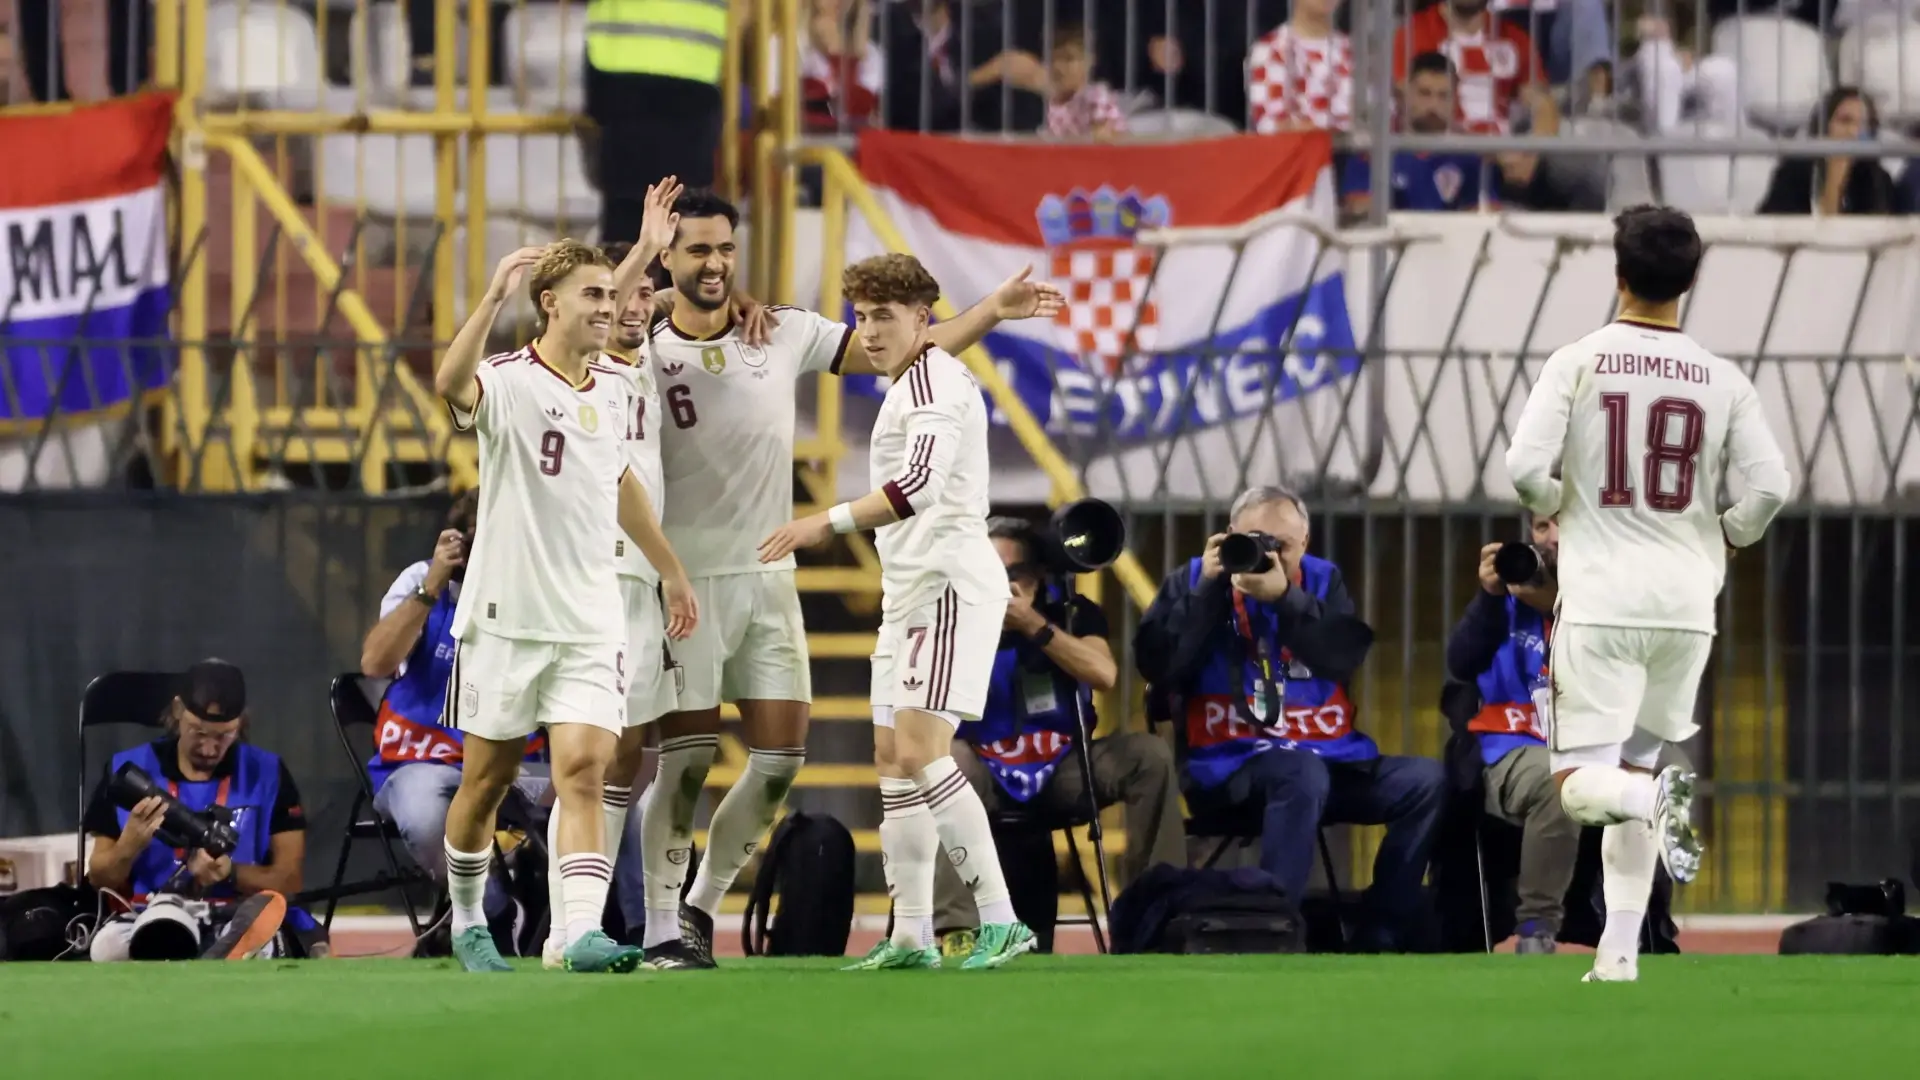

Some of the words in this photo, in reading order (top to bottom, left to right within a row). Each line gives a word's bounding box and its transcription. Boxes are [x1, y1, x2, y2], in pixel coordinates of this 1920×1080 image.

[1594, 353, 1711, 386] ZUBIMENDI
[666, 383, 698, 430] 6
[539, 429, 566, 477] 9
[1599, 391, 1706, 514] 18
[906, 625, 928, 669] 7
